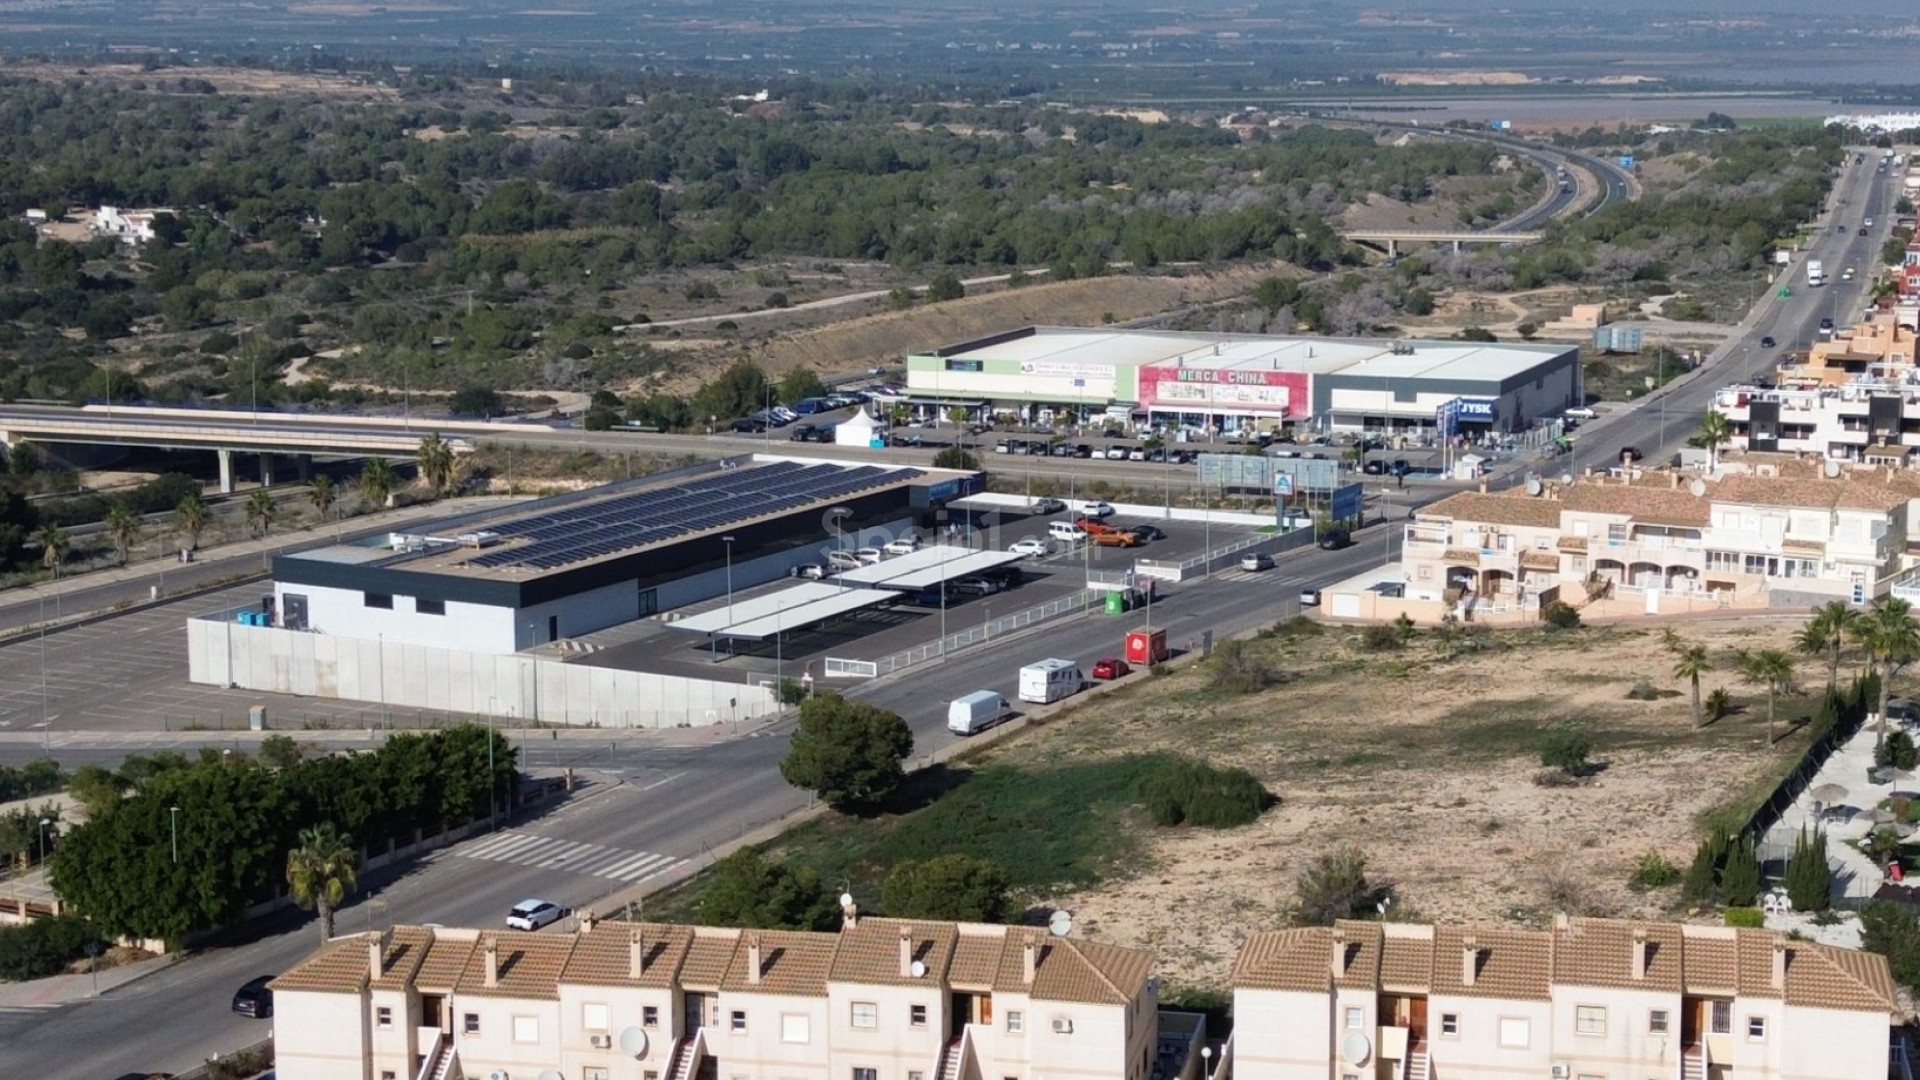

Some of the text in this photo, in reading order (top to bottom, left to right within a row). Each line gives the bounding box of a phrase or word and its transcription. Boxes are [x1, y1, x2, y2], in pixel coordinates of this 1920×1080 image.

[1177, 368, 1268, 385] MERCA CHINA
[1461, 403, 1492, 414] JYSK
